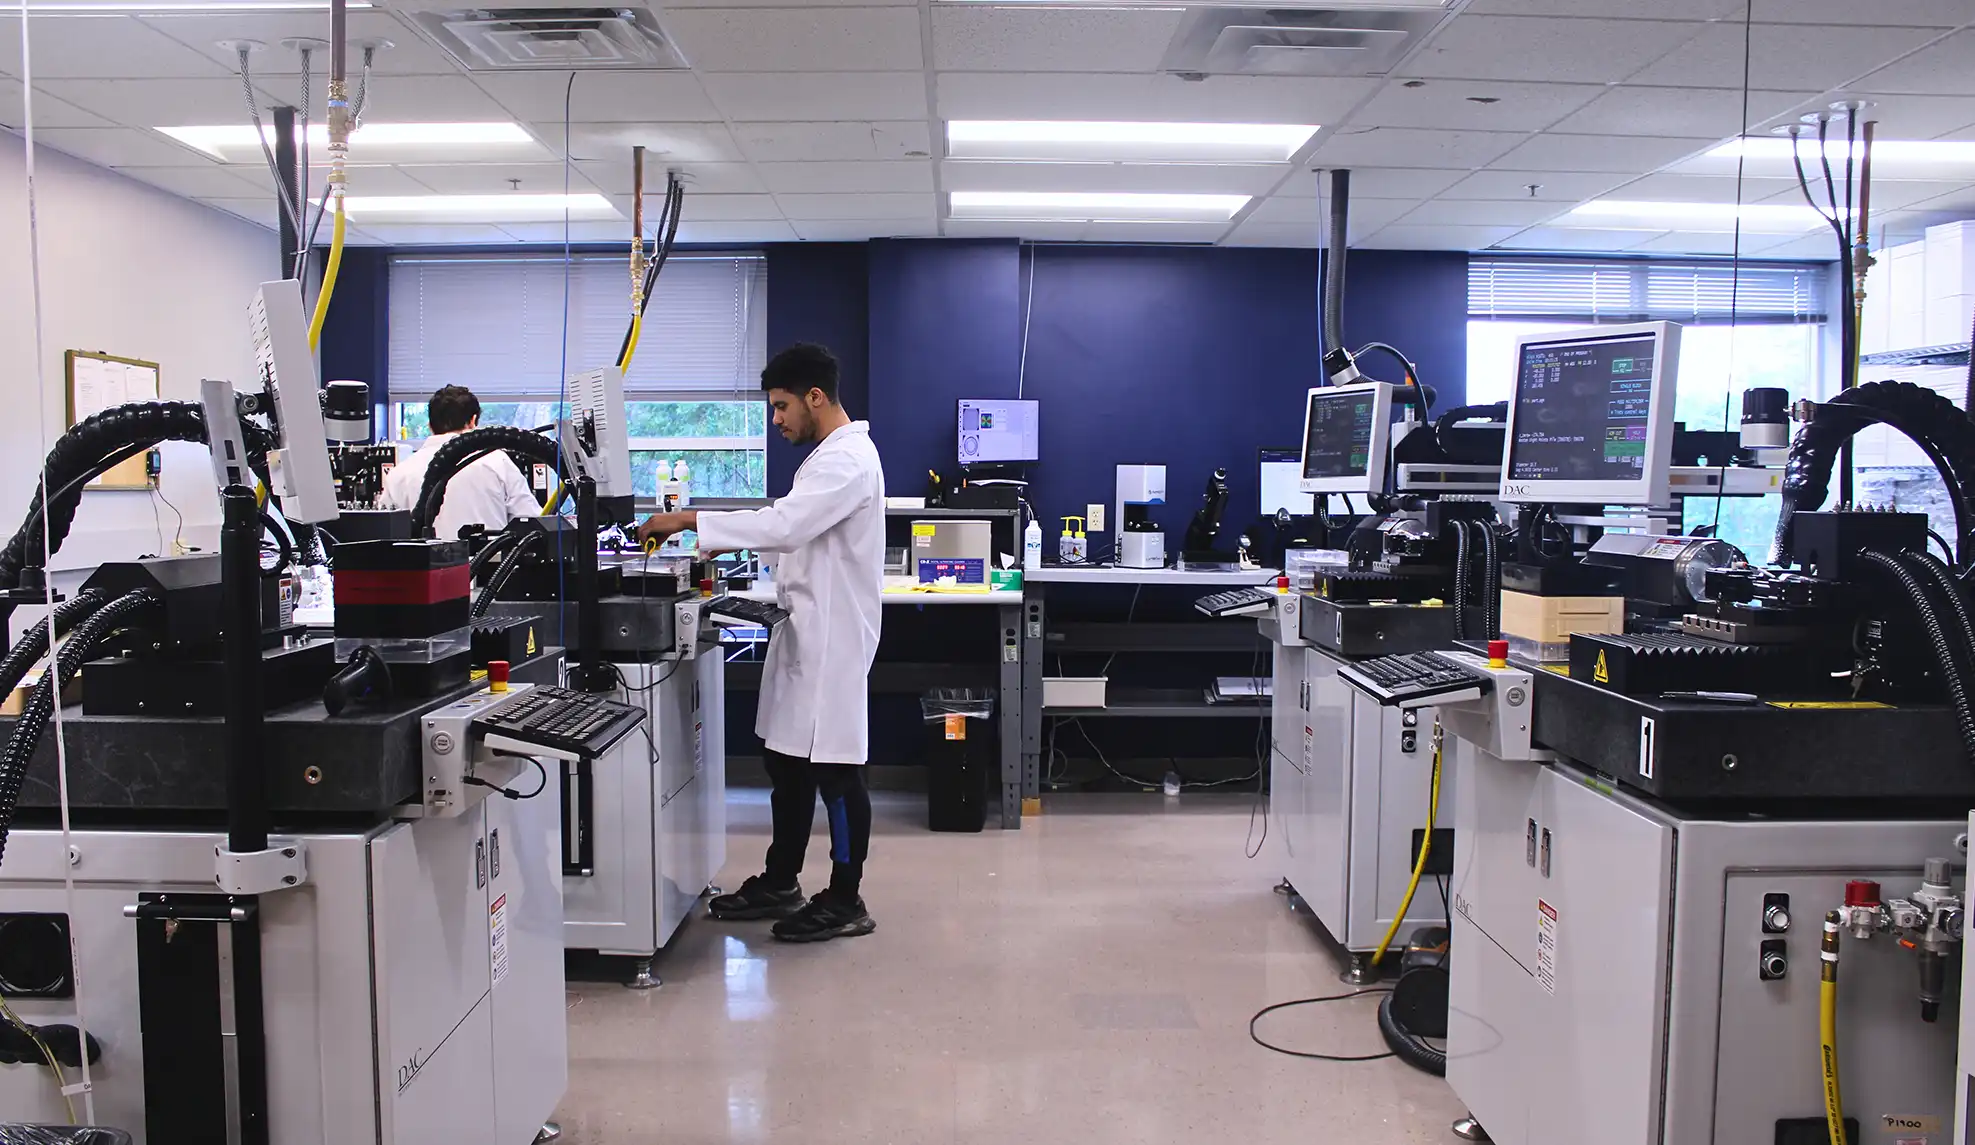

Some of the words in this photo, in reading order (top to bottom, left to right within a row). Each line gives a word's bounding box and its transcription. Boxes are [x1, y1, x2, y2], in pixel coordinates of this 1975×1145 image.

[1504, 484, 1530, 495] DAC
[1644, 721, 1651, 775] 1
[398, 1047, 422, 1088] DAC
[1887, 1117, 1922, 1129] P1900
